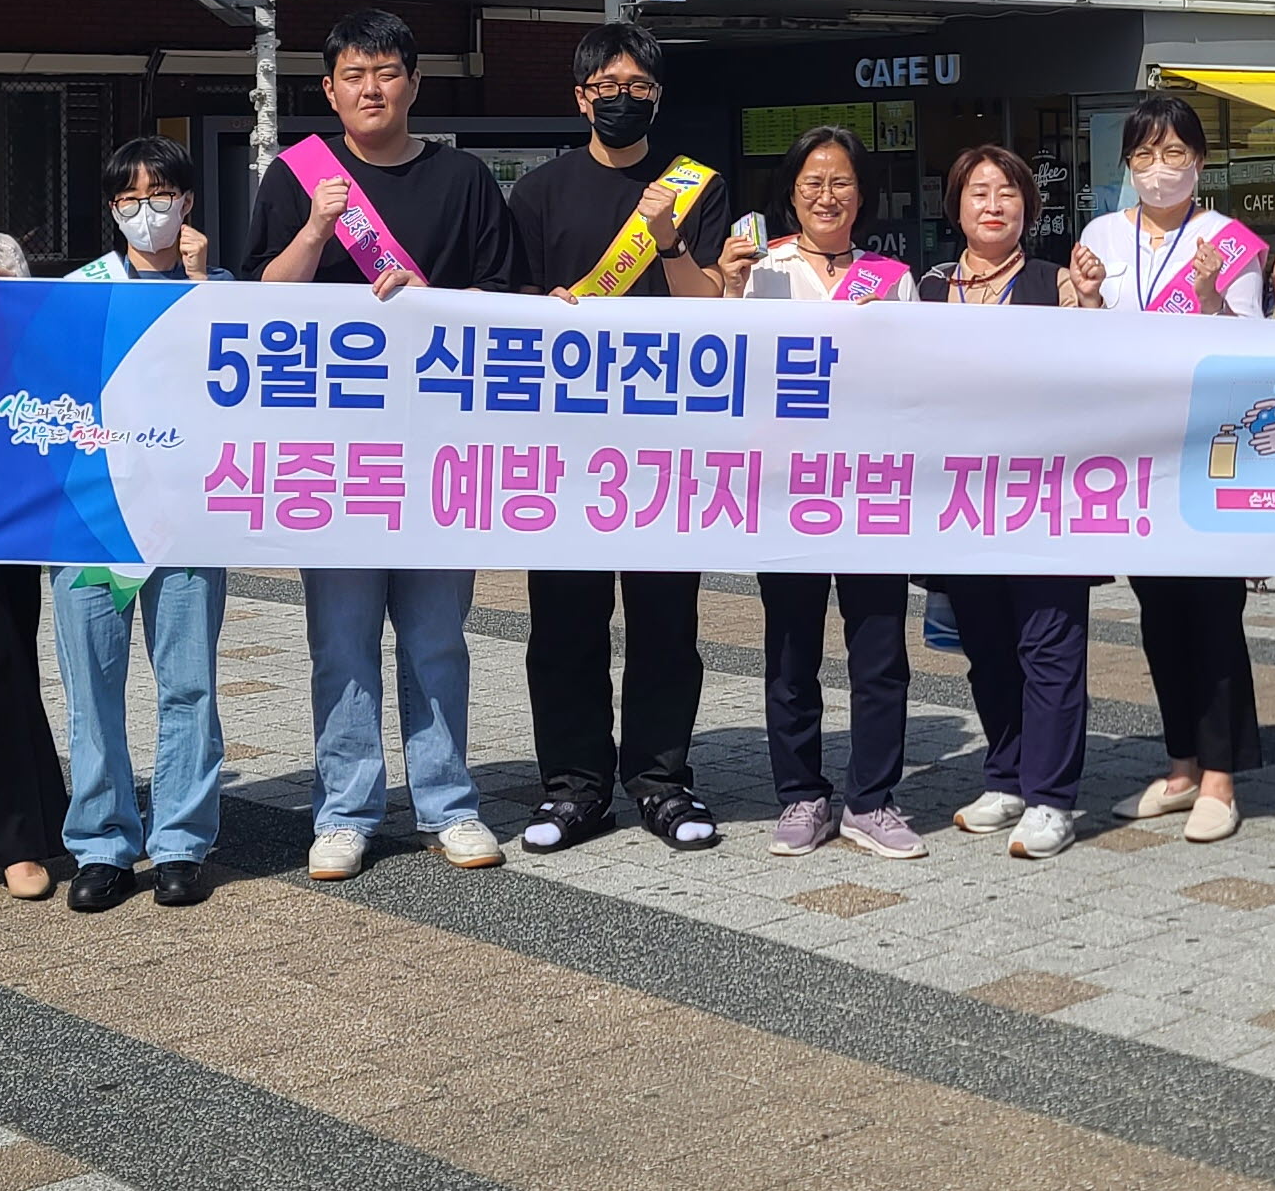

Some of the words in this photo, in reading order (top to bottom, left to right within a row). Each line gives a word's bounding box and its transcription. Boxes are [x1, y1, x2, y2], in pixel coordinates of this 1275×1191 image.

[855, 56, 929, 88] CAFE
[934, 53, 961, 85] U
[1032, 161, 1069, 188] offee
[1243, 194, 1275, 211] CAFE
[206, 319, 389, 409] 5월은
[414, 324, 748, 419] 식품안전의
[775, 335, 840, 420] 달
[13, 425, 68, 454] 자유로운
[71, 425, 131, 452] 혁신도시
[135, 426, 185, 449] 안산
[203, 440, 407, 532] 식중독
[430, 443, 565, 533] 예방
[585, 447, 763, 534] 3가지
[788, 451, 915, 537] 방법
[937, 455, 1154, 538] 지켜요!
